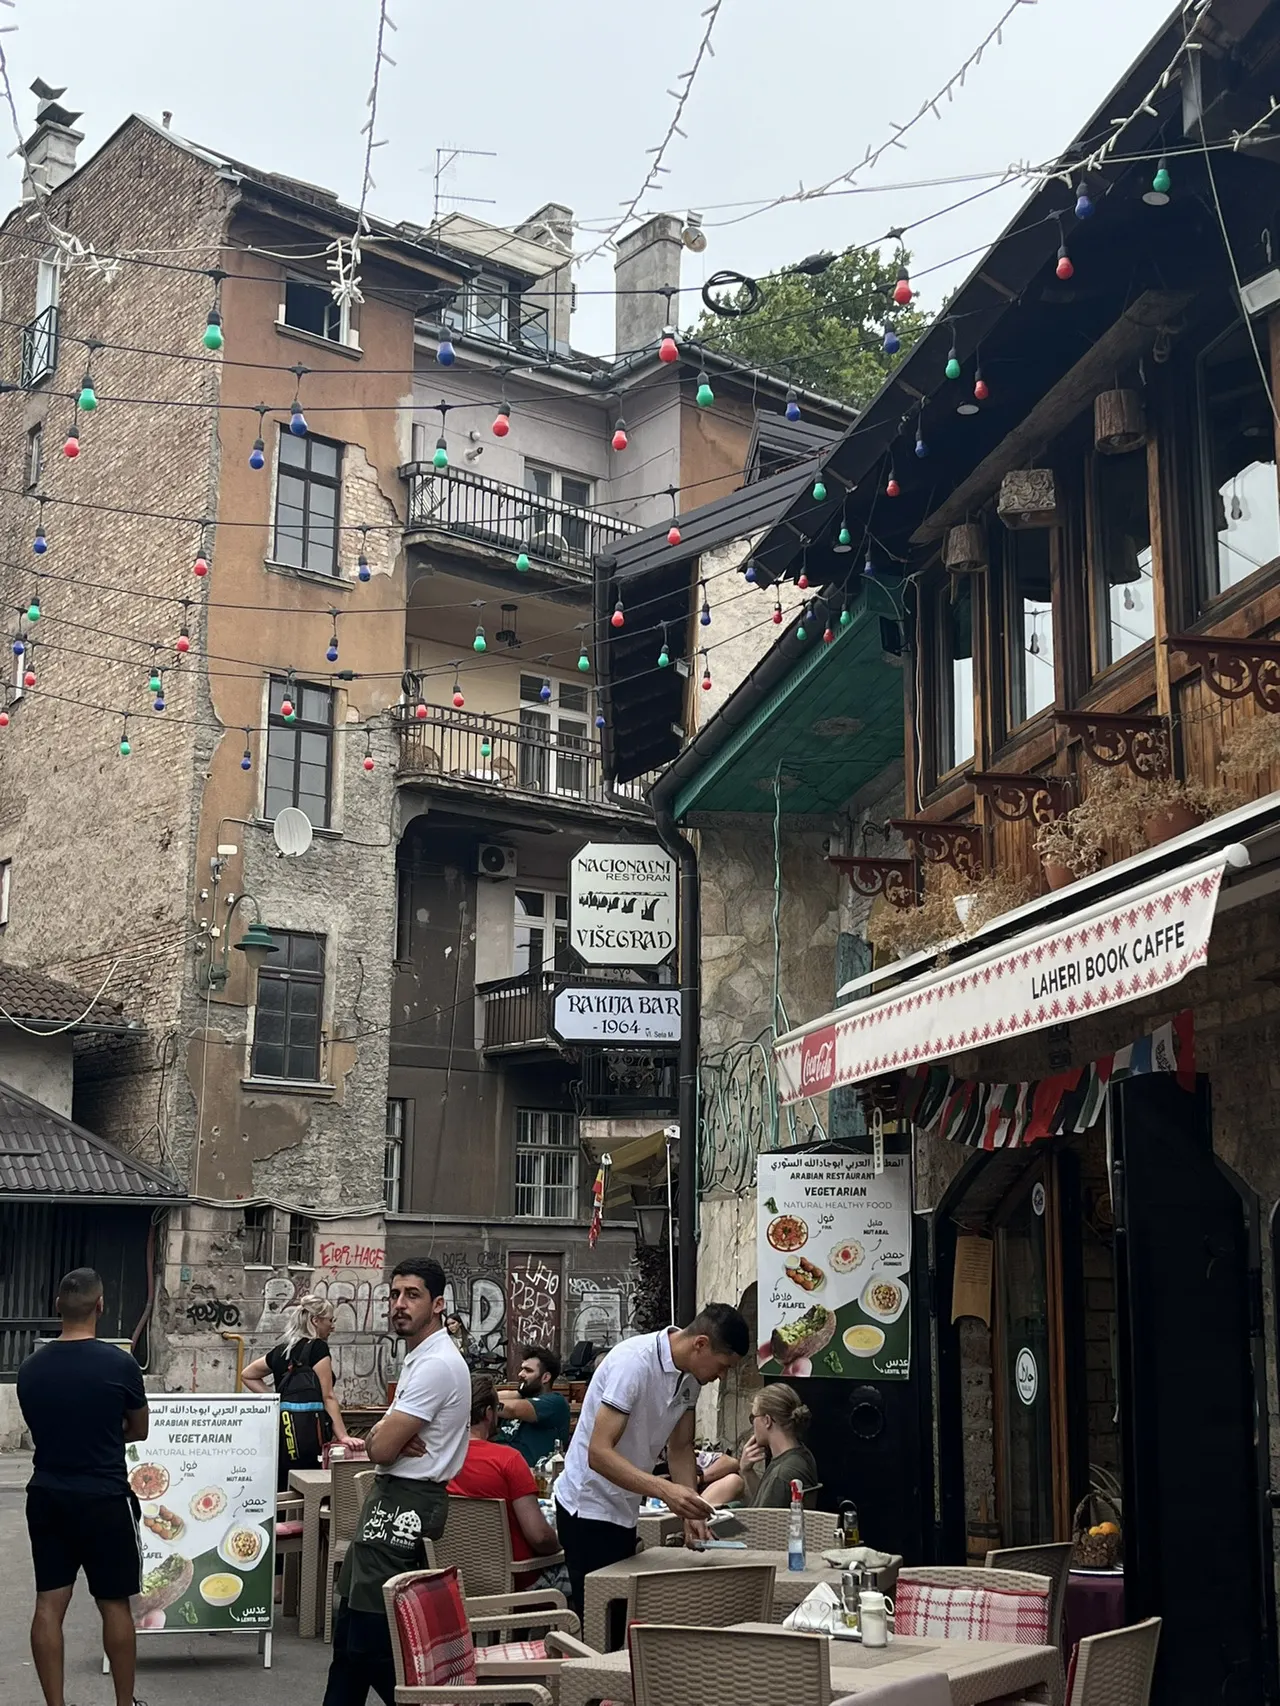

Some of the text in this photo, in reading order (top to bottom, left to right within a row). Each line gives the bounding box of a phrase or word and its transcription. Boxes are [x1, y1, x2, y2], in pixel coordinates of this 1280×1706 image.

[578, 858, 671, 874] NACIONALNI
[605, 873, 671, 882] RESTORAN
[576, 924, 672, 950] VIŠEGRAD
[1031, 920, 1185, 999] LAHERI BOOK CAFFE
[567, 994, 682, 1017] RAKIJA BAR
[601, 1019, 640, 1034] 1964
[790, 1172, 824, 1180] ARABIAN
[804, 1186, 867, 1197] VEGETARIAN
[783, 1201, 892, 1210] NATURAL HEALTHY FOOD
[817, 1213, 835, 1225] فول
[879, 1251, 905, 1261] حمص
[211, 1404, 238, 1418] العربي
[239, 1404, 271, 1416] المطعم
[154, 1419, 243, 1427] ARABIAN RESTAURANT
[168, 1433, 233, 1443] VEGETARIAN
[281, 1410, 298, 1461] HEAD
[145, 1448, 257, 1456] NATURAL HEALTHY FOOD
[180, 1460, 198, 1472] فول
[241, 1498, 267, 1508] حمص
[390, 1536, 416, 1548] Arabic
[242, 1606, 266, 1617] عدس
